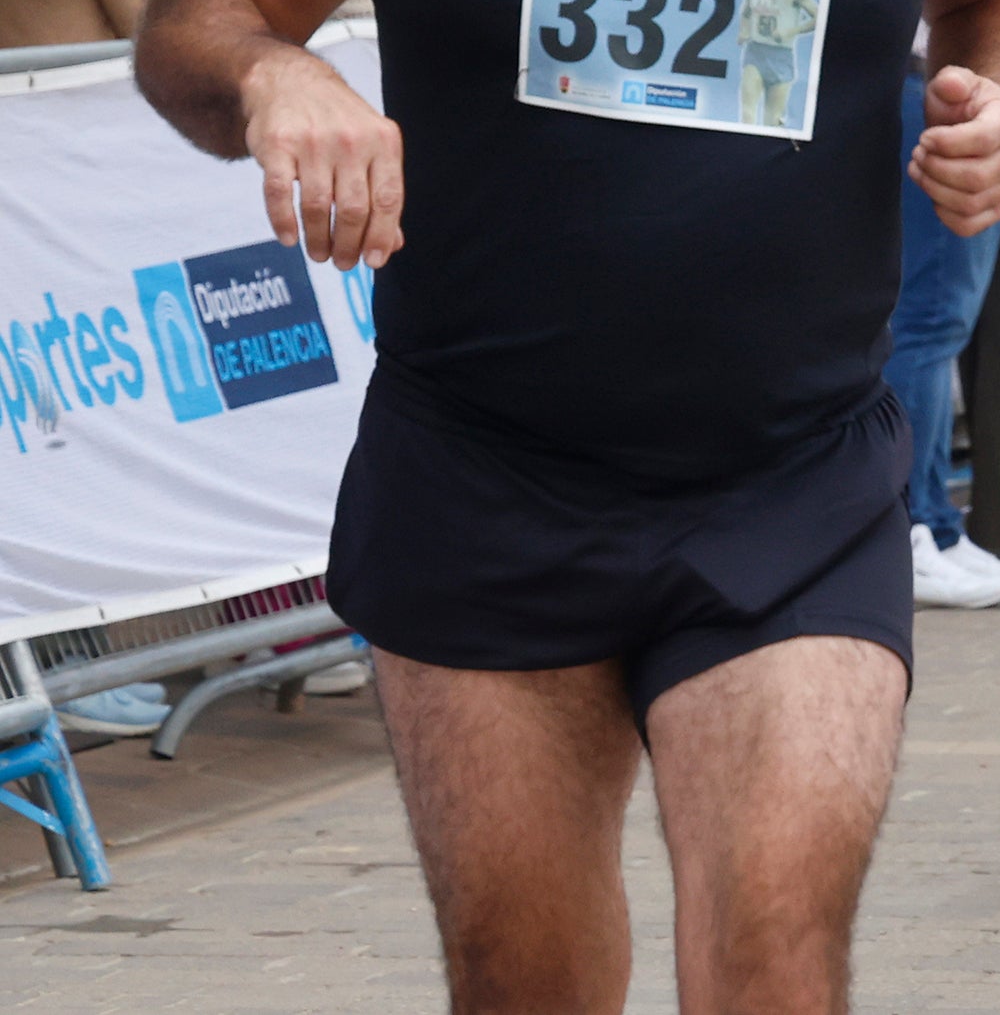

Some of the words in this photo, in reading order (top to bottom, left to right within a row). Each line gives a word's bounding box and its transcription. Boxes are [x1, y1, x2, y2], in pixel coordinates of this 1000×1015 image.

[193, 268, 292, 329] Diputación
[213, 343, 246, 383] DE
[238, 322, 331, 377] PALENCIA
